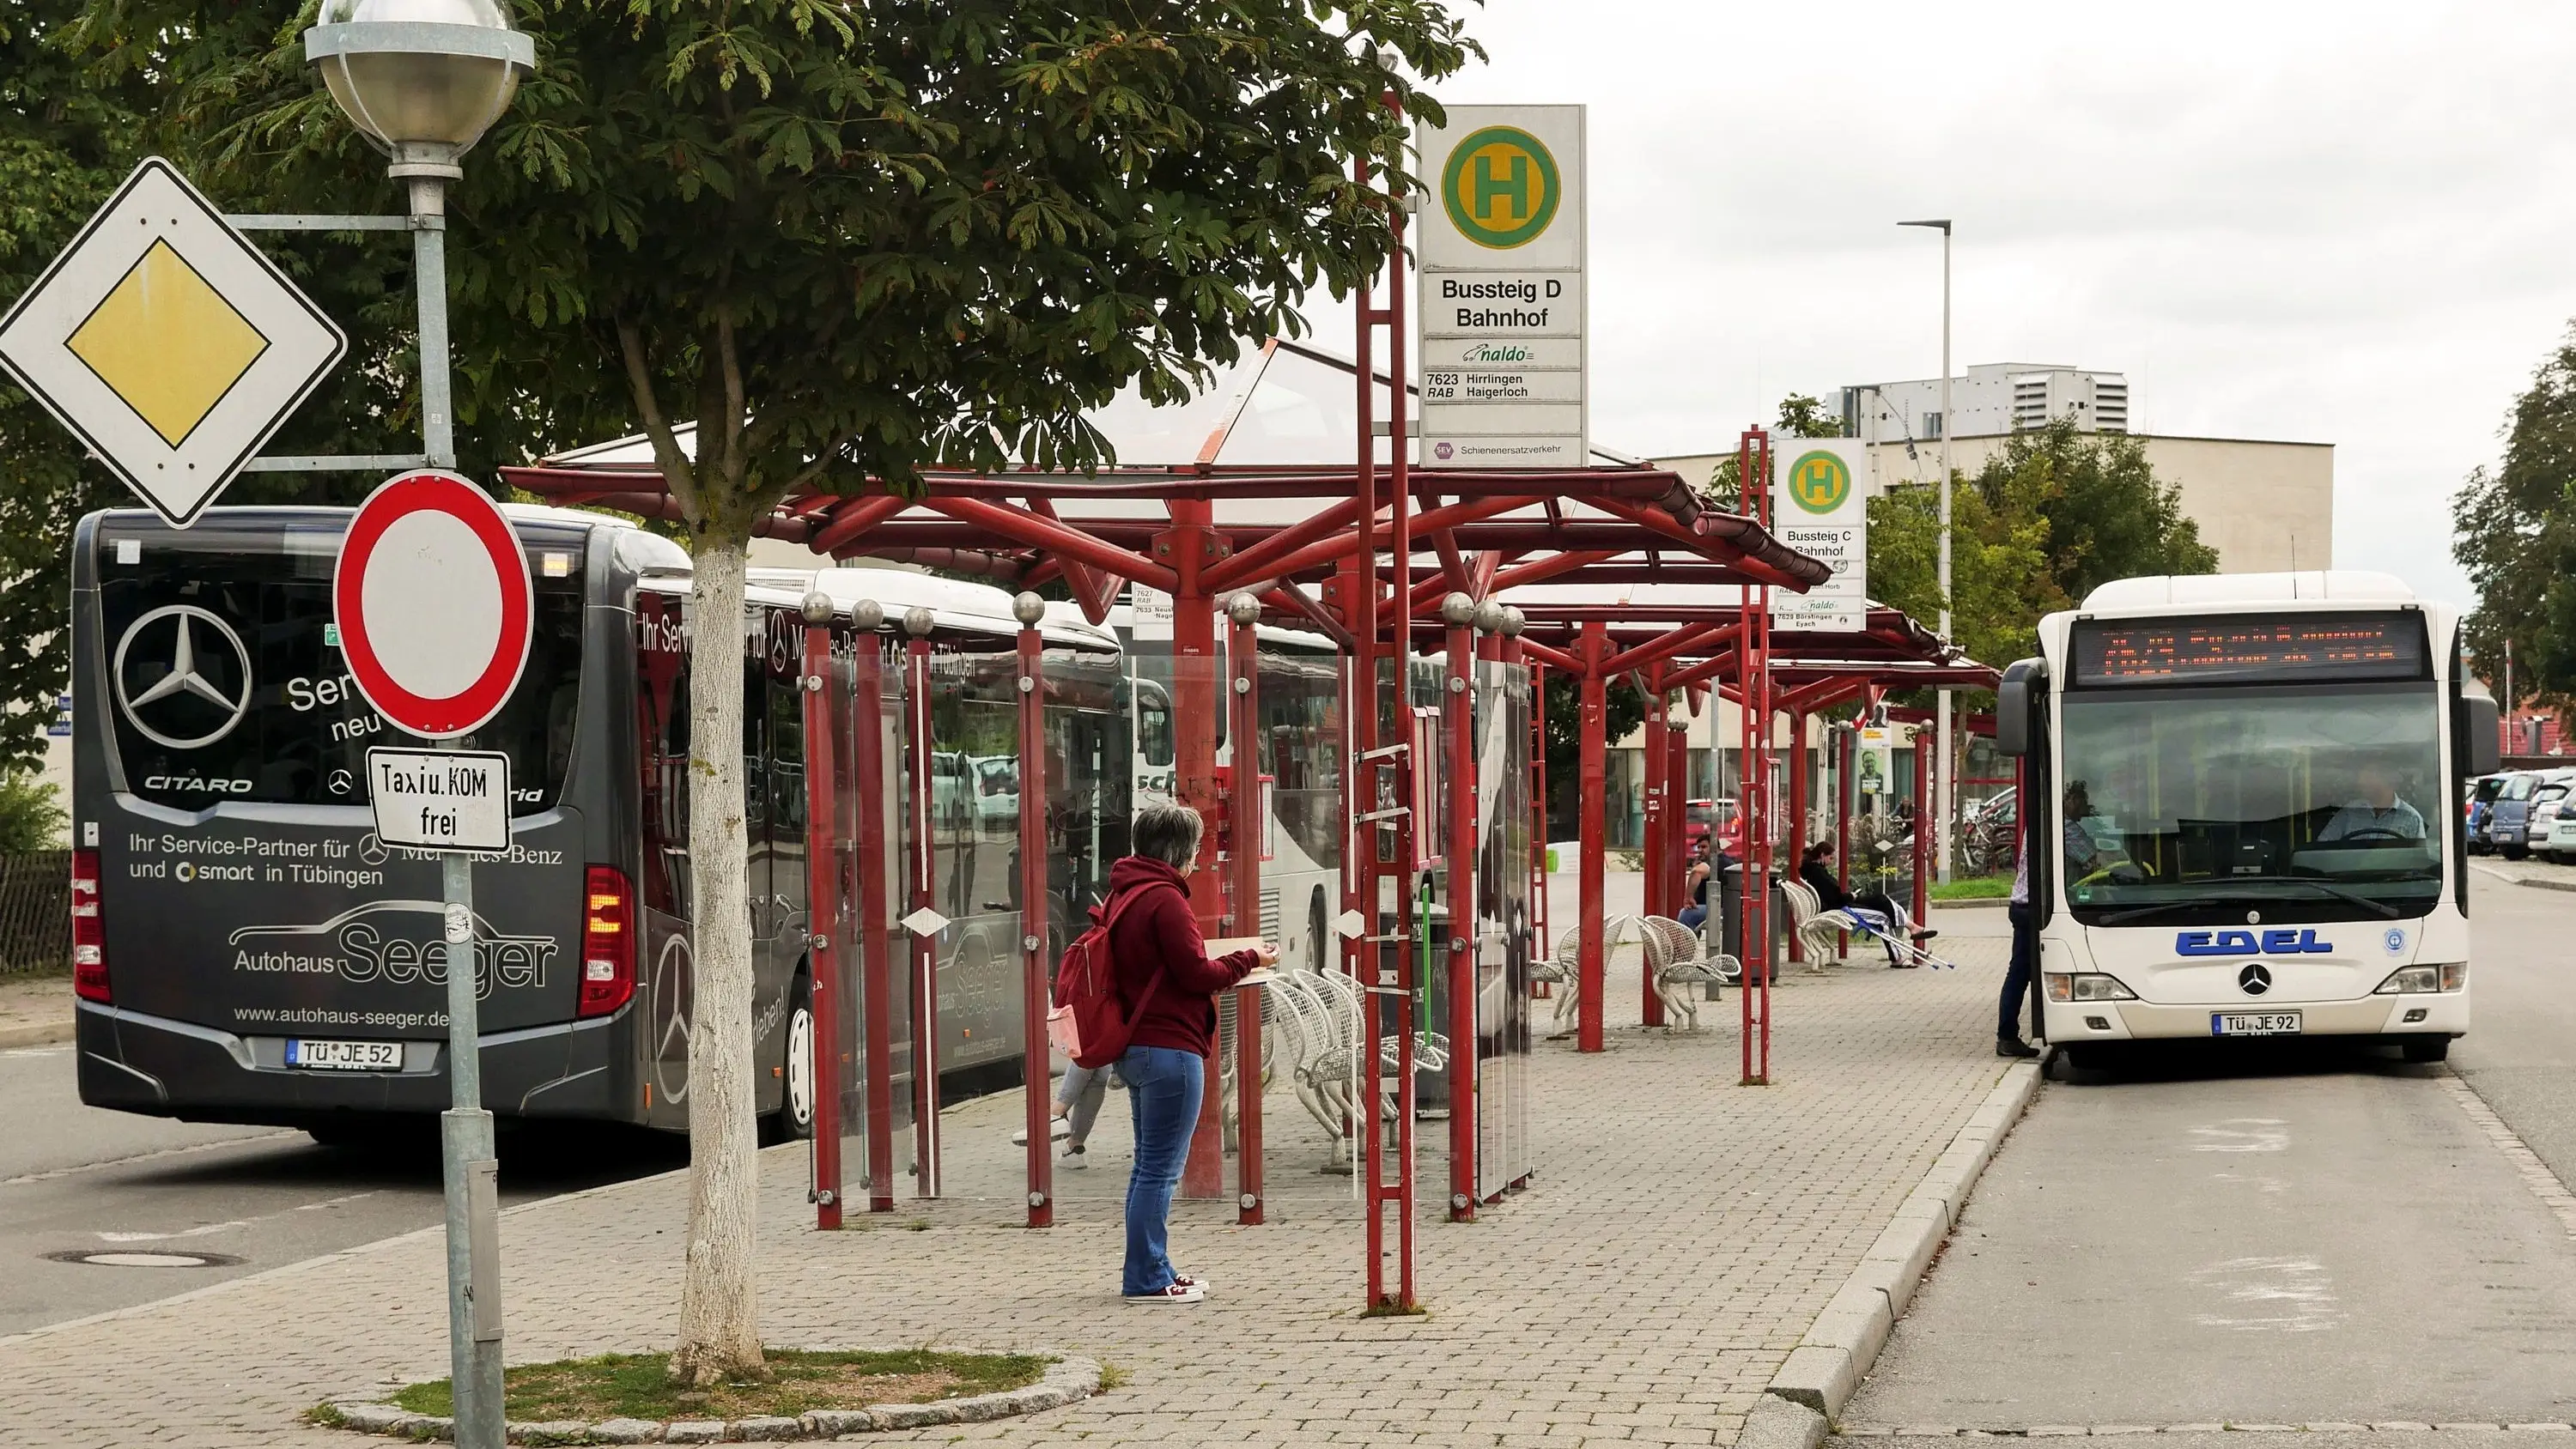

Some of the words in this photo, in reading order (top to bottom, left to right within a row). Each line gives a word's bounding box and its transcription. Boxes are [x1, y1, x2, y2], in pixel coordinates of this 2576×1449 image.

[1474, 155, 1528, 219] H
[1443, 280, 1536, 303] Bussteig
[1546, 280, 1561, 298] D
[1456, 308, 1548, 327] Bahnhof
[1480, 346, 1526, 362] naldo
[1427, 374, 1459, 385] 7623
[1467, 374, 1522, 385] Hirrlingen
[1427, 388, 1454, 397] RAB
[1467, 387, 1528, 399] Haigerloch
[1436, 446, 1452, 454] SEV
[1461, 445, 1561, 455] Schienenersatzverkehr
[1805, 465, 1834, 499] H
[1788, 531, 1838, 543] Bussteig
[1843, 530, 1851, 541] C
[1810, 601, 1834, 610] naldo
[642, 612, 659, 651] Ihr
[752, 622, 767, 658] für
[331, 713, 381, 742] neu
[144, 775, 252, 793] CITARO
[381, 764, 425, 794] Taxi
[421, 807, 457, 836] frei
[130, 834, 155, 852] Ihr
[161, 834, 318, 858] Service-Partner
[323, 839, 350, 858] für
[130, 860, 166, 878] und
[198, 865, 255, 882] smart
[265, 864, 283, 882] in
[289, 864, 383, 889] Tübingen
[2175, 929, 2333, 957] EDEL
[234, 949, 334, 973] Autohaus
[234, 1005, 451, 1028] www.autohaus-seeger.de
[2255, 1016, 2274, 1030] JE
[2277, 1016, 2294, 1029] 92
[341, 1044, 364, 1063] JE
[369, 1046, 392, 1064] 52
